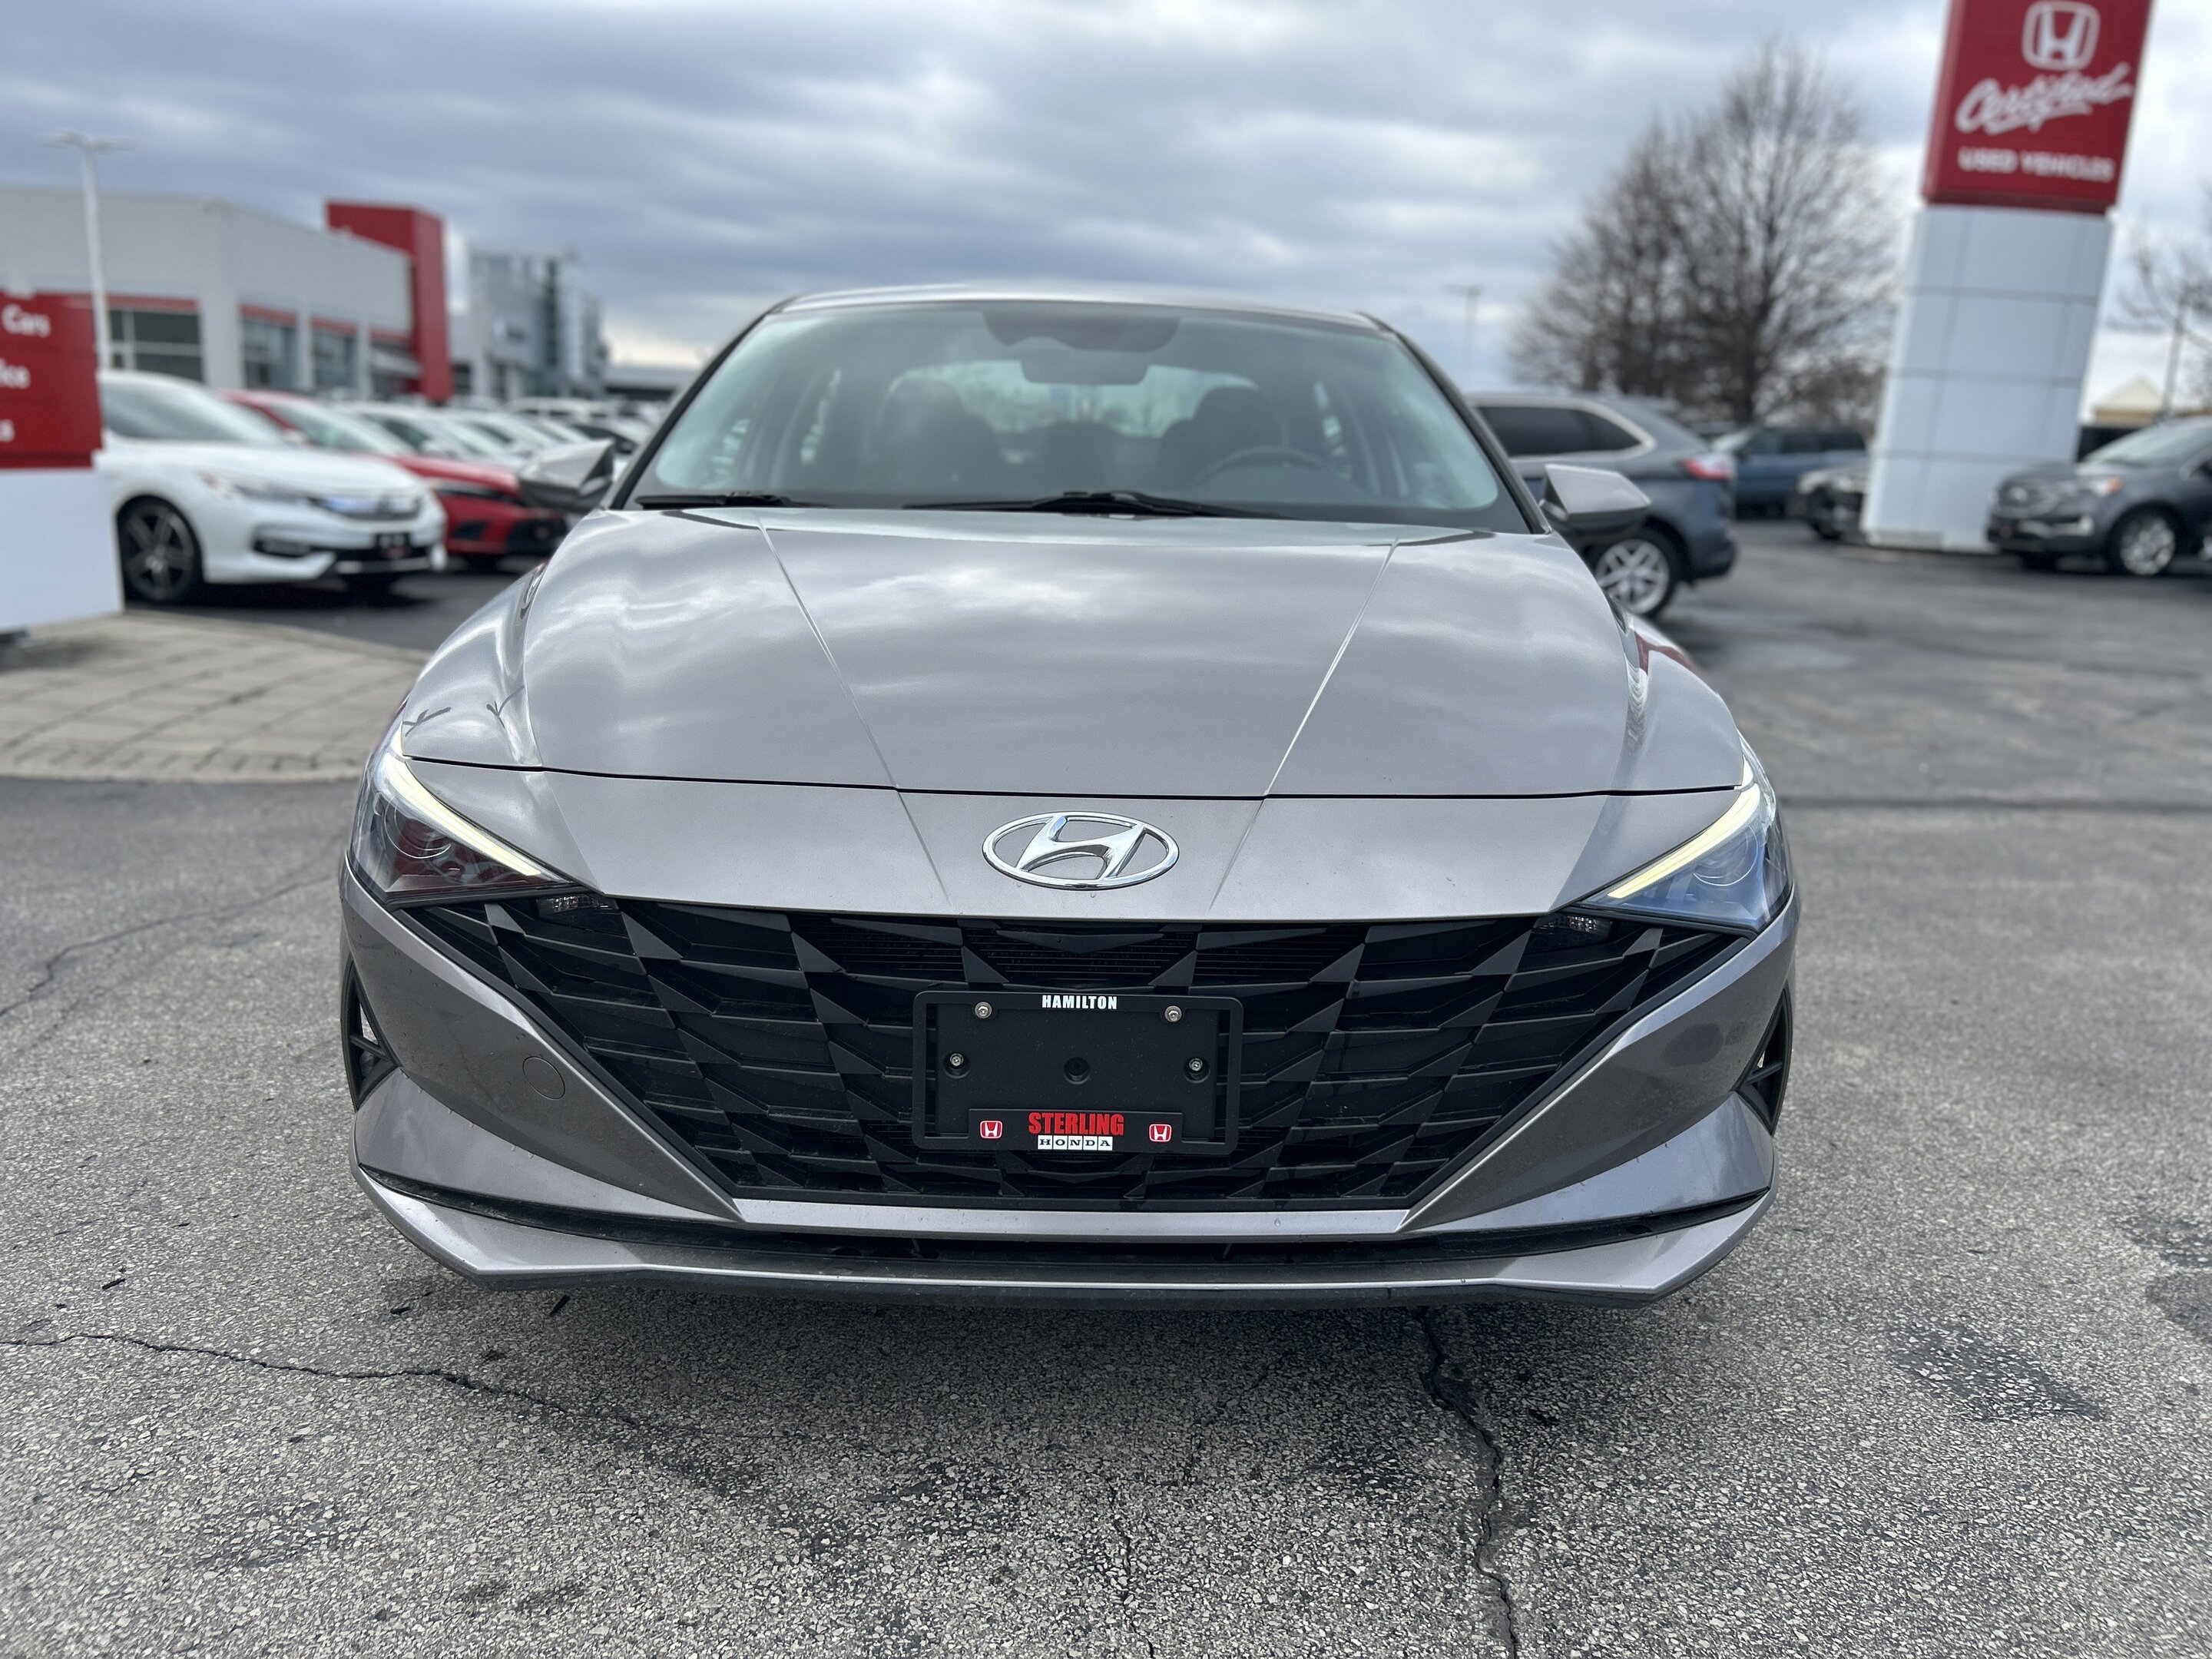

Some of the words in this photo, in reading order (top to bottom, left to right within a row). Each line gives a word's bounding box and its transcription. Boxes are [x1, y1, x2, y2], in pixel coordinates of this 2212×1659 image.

[1959, 147, 2017, 172] USED
[2, 304, 51, 337] Cars
[1041, 995, 1118, 1009] HAMILTON
[1028, 1111, 1124, 1135] STERLING
[1038, 1137, 1111, 1147] HONDA
